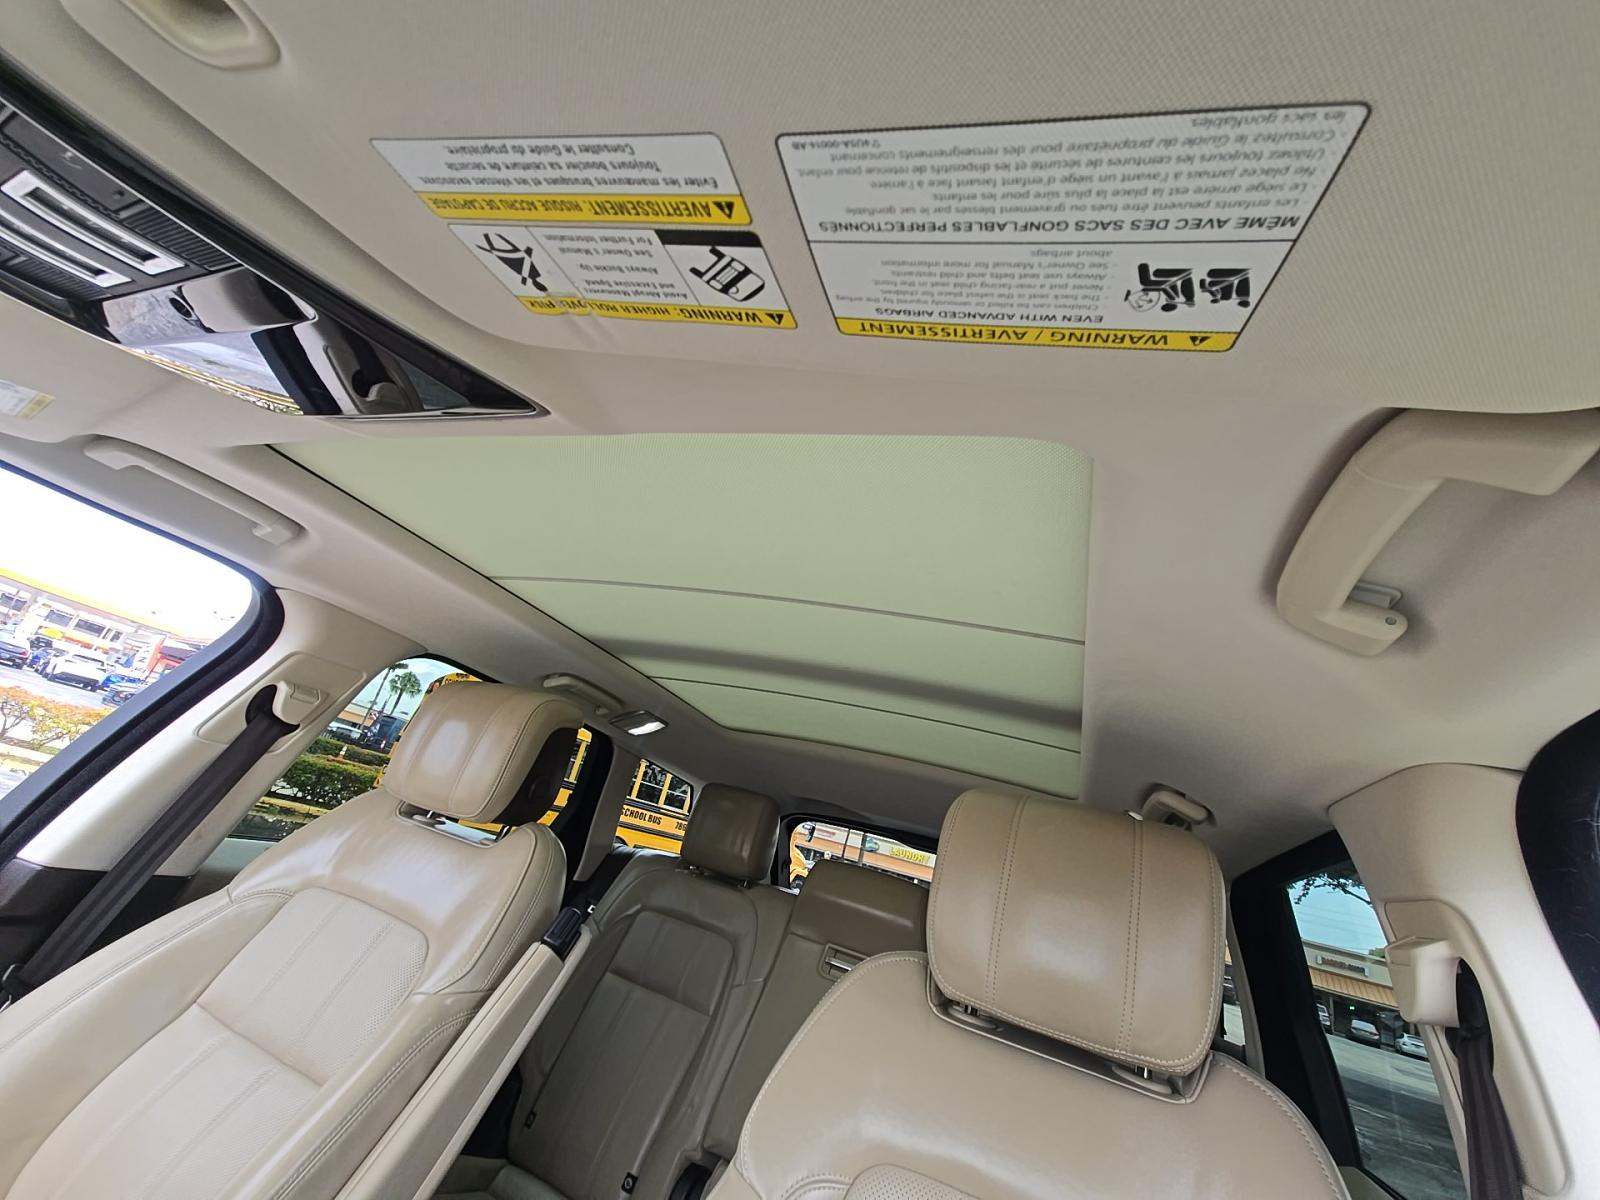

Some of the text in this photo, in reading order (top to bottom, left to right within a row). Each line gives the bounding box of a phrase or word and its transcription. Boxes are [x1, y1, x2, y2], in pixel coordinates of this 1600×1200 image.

[818, 216, 1301, 234] MÊME AVEC DES SACS GONFLABLES PERFECTIONNÉS
[620, 304, 670, 317] HIGHER
[875, 308, 1104, 323] EVEN WITH ADVANCED AIRBAGS
[858, 322, 1028, 344] AVERTISSEMENT
[1050, 331, 1169, 346] WARNING
[647, 814, 662, 825] BUS
